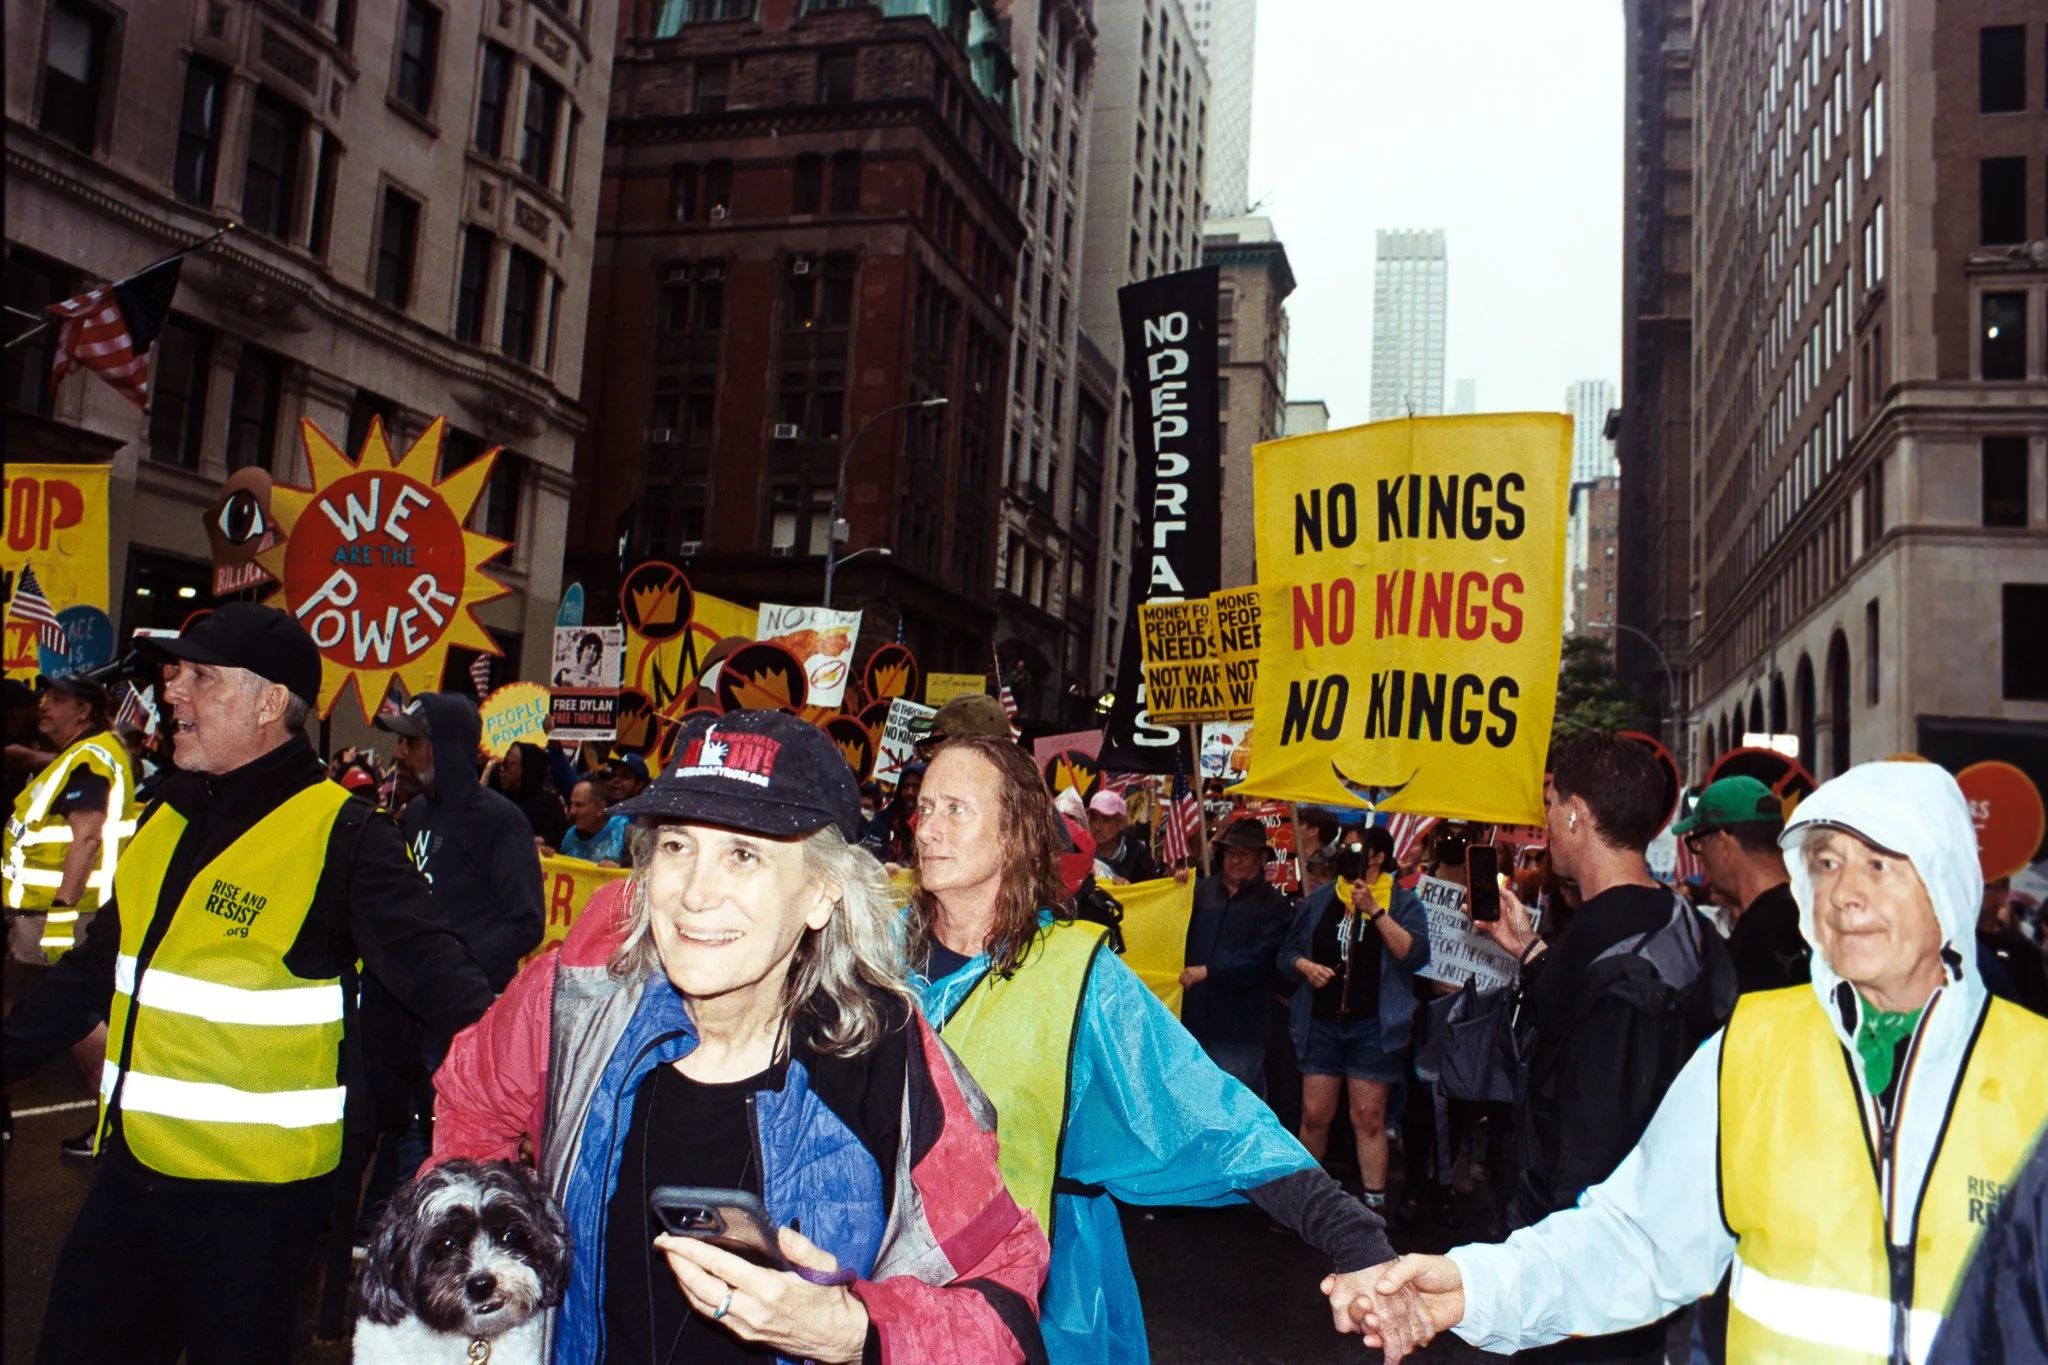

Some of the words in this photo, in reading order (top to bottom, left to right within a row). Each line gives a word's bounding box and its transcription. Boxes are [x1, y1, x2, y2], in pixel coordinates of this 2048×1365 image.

[1144, 311, 1188, 347] NO
[4, 476, 84, 552] OP
[319, 478, 431, 543] WE
[1294, 482, 1357, 555] NO
[1376, 472, 1525, 542] KINGS
[333, 545, 373, 564] ARE
[379, 545, 416, 565] THE
[295, 568, 456, 664] POWER
[767, 607, 805, 630] NO
[1143, 605, 1188, 621] MONEY
[1292, 577, 1355, 651] NO
[1375, 569, 1525, 644] KINGS
[1149, 666, 1181, 687] NOT
[1225, 659, 1259, 682] NOT
[553, 699, 577, 711] FREE
[579, 699, 613, 711] DYLAN
[1151, 687, 1177, 710] W/
[1280, 674, 1349, 746] NO
[1364, 670, 1519, 748] KINGS
[487, 698, 545, 732] PEOPLE
[553, 713, 571, 724] FREE
[573, 713, 594, 724] THEM
[596, 714, 612, 725] ALL
[889, 713, 898, 724] NO
[492, 717, 545, 748] POWER
[884, 725, 898, 740] NO
[212, 879, 241, 901] RISE
[241, 891, 268, 911] AND
[205, 894, 261, 927] RESIST
[223, 926, 250, 939] .org
